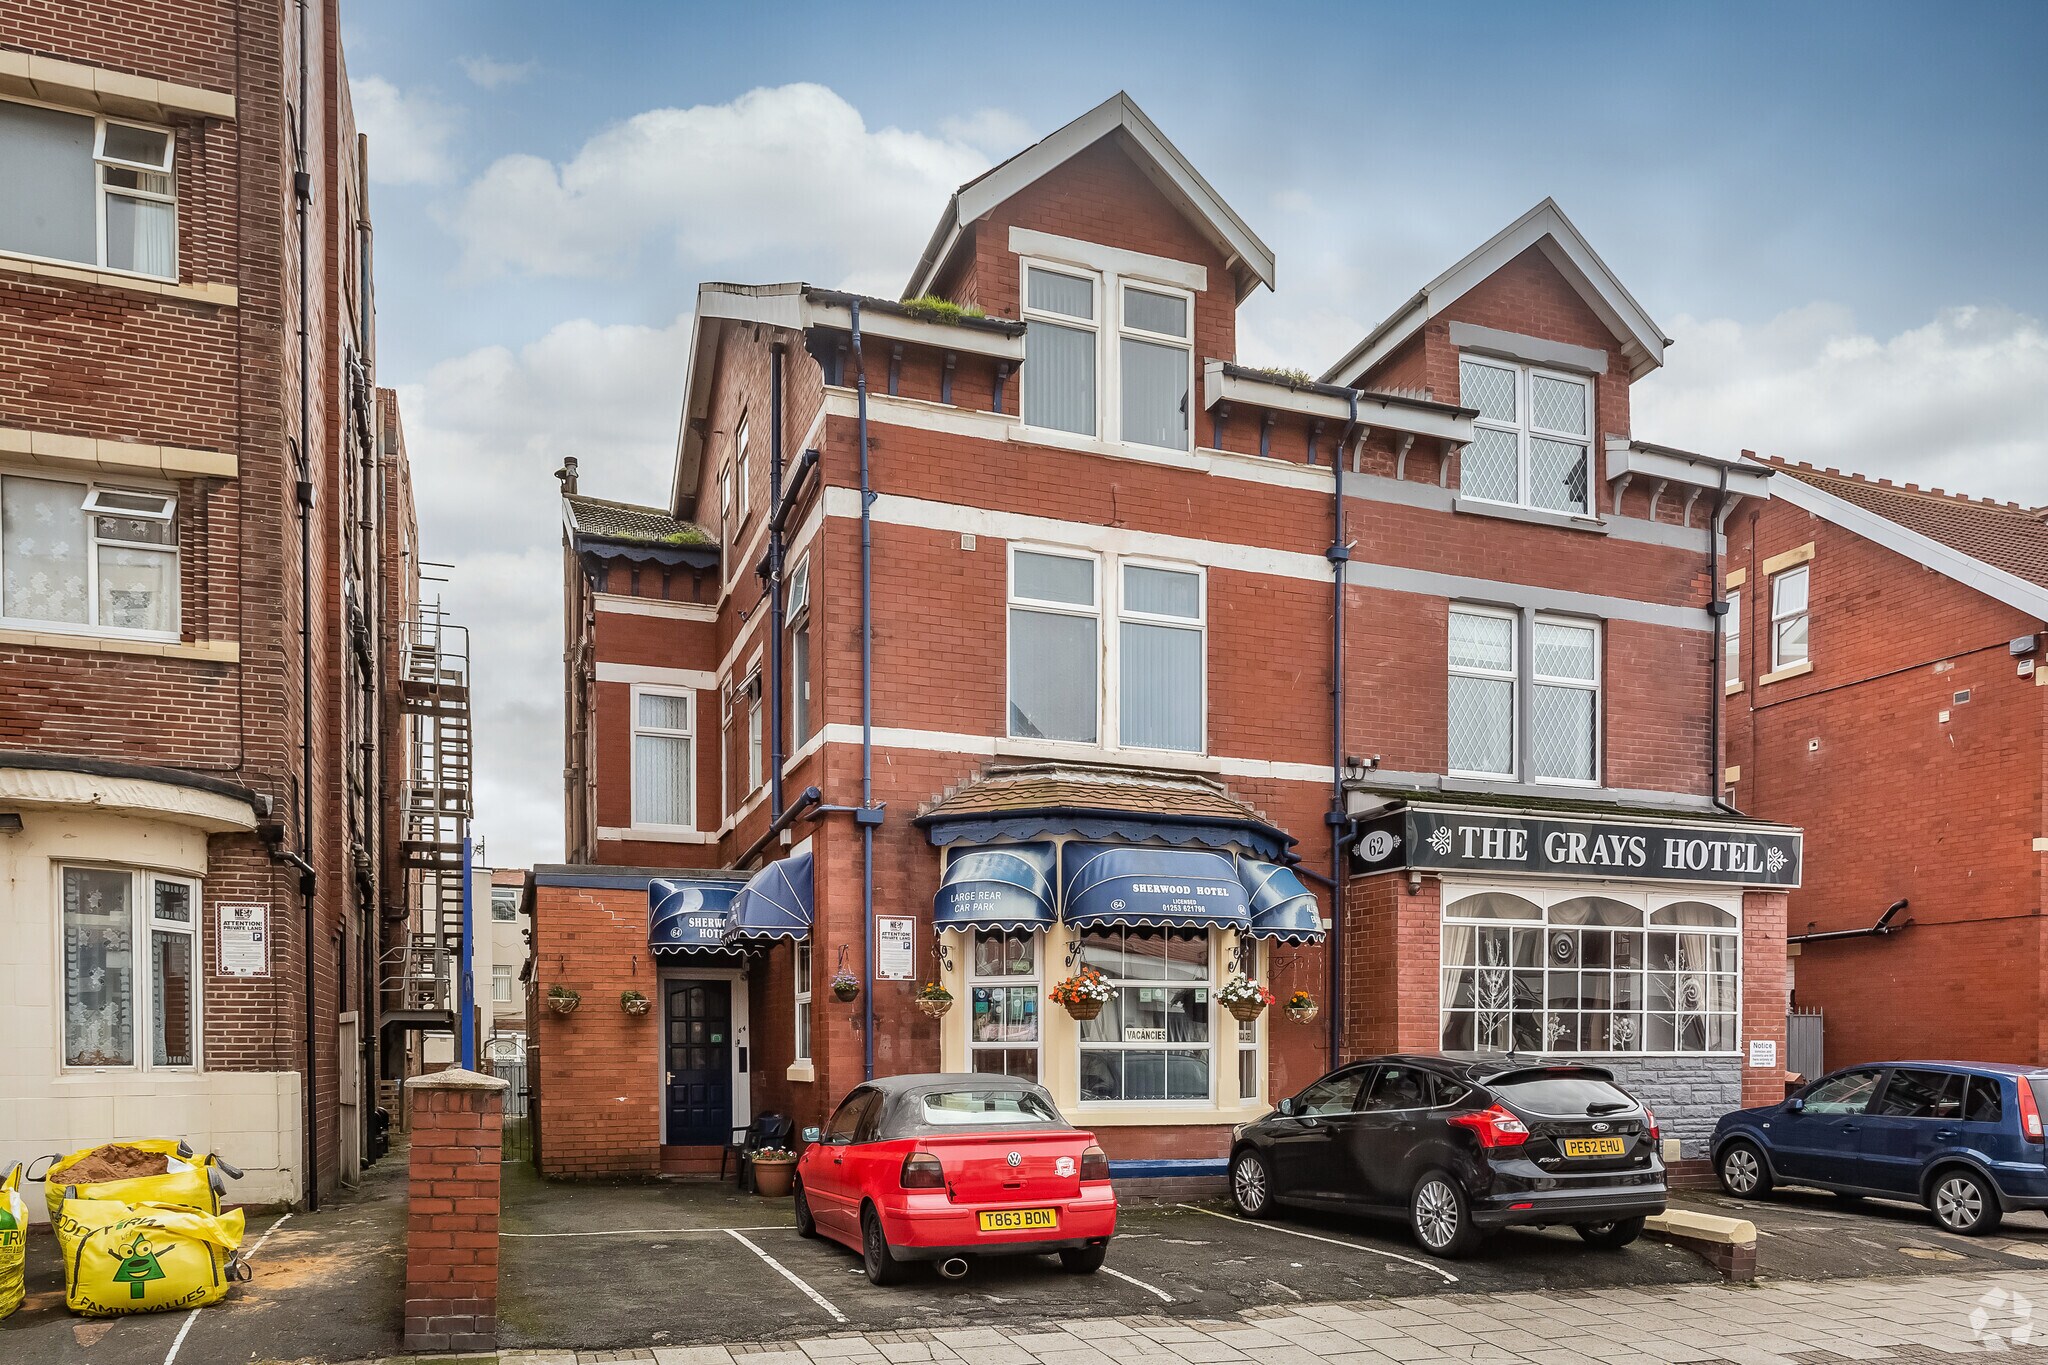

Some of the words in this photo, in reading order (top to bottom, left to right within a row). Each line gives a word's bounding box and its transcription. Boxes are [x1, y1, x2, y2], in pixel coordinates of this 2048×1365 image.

[1368, 836, 1384, 857] 62
[1458, 826, 1528, 862] THE
[1544, 831, 1647, 868] GRAYS
[1662, 838, 1764, 874] HOTEL
[1132, 884, 1191, 895] SHERWOOD
[1196, 886, 1230, 897] HOTEL
[950, 891, 976, 903] LARGE
[978, 891, 1002, 900] REAR
[954, 903, 970, 913] CAR
[972, 902, 995, 911] PARK
[1113, 901, 1123, 909] 64
[1162, 904, 1181, 912] 01253
[672, 929, 681, 938] 64
[1126, 1030, 1166, 1041] VACANCIES
[1570, 1140, 1598, 1153] PE62
[1600, 1139, 1620, 1152] EHU
[985, 1212, 1021, 1227] T863
[1025, 1211, 1051, 1225] BON
[144, 1285, 207, 1314] VALUES
